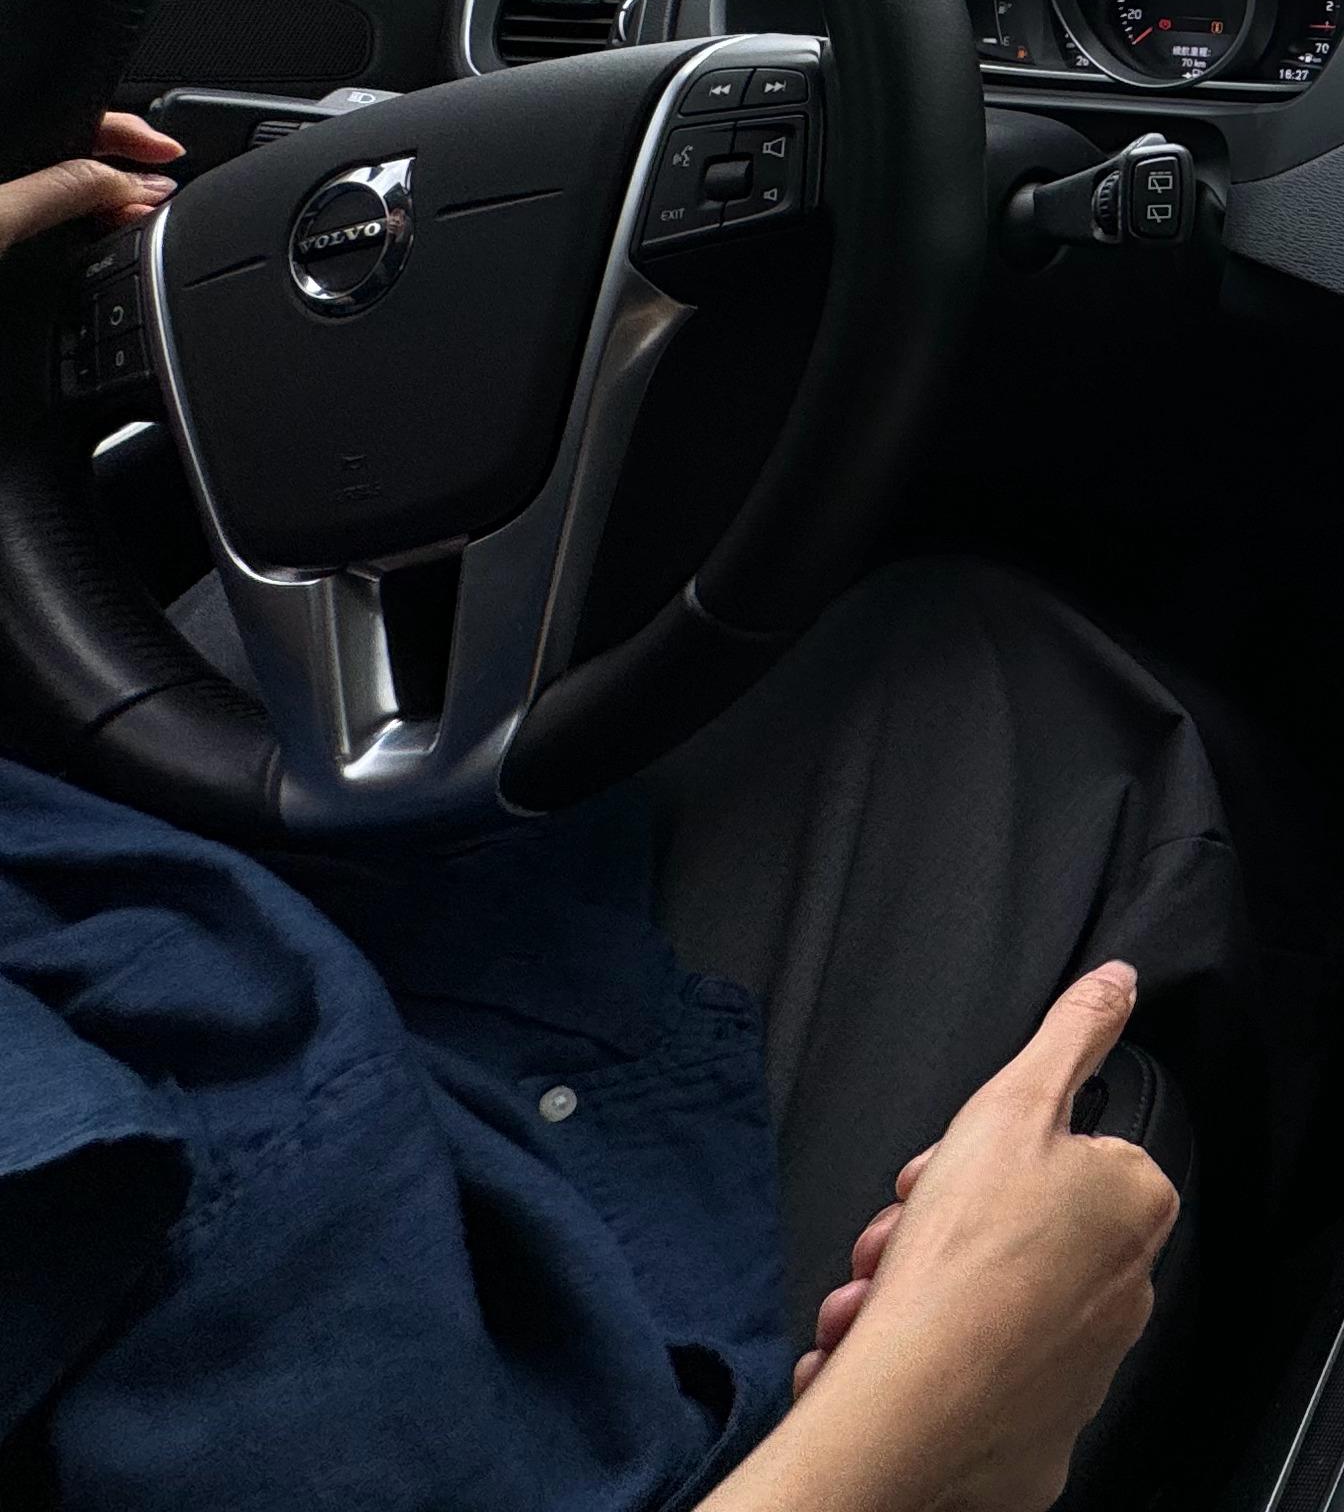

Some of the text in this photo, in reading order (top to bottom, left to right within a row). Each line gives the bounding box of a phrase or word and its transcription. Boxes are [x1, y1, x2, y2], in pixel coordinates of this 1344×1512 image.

[1325, 1, 1334, 12] 2
[1127, 9, 1143, 20] 20
[1315, 43, 1330, 54] 70
[1279, 69, 1309, 81] 16:27
[660, 207, 685, 221] EXIT
[299, 222, 381, 254] VOLVO
